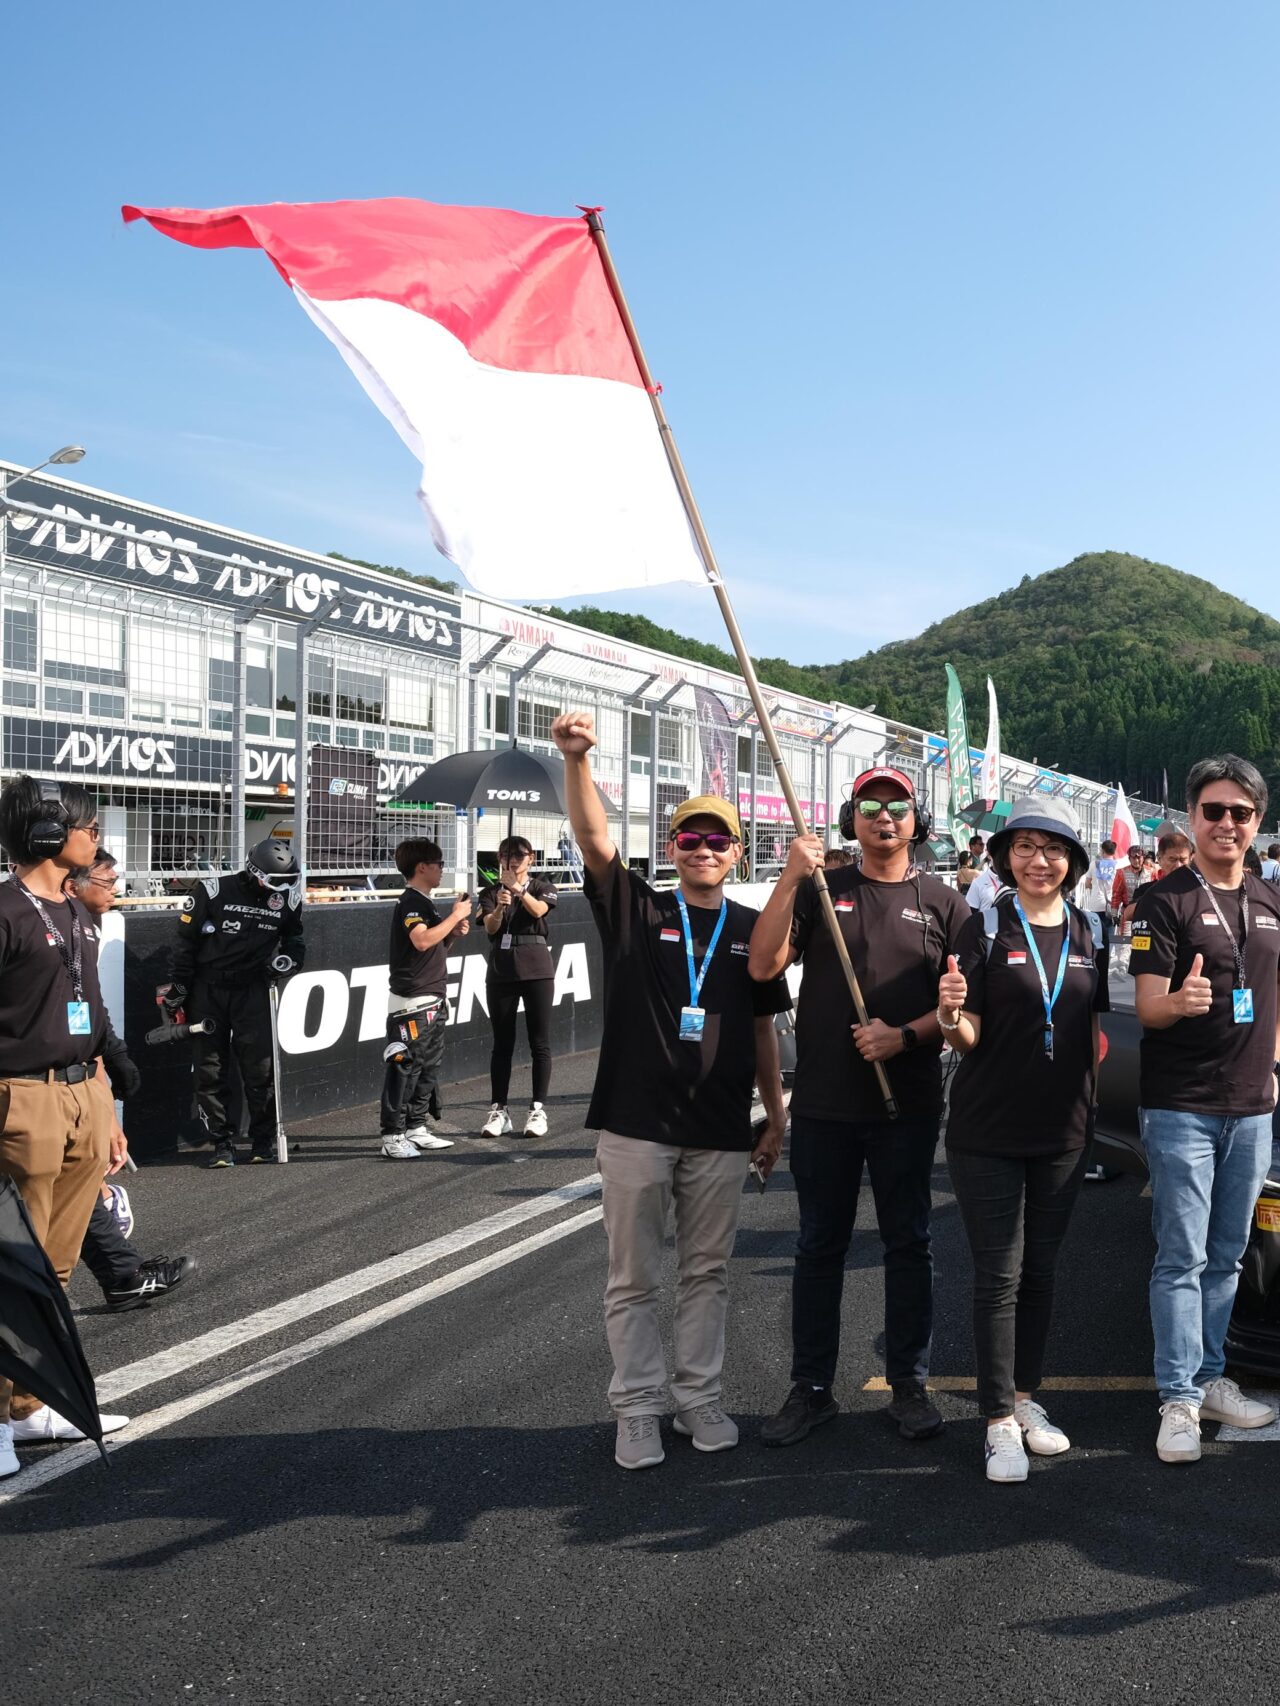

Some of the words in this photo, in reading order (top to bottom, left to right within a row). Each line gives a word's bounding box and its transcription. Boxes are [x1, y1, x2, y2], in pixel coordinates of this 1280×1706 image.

[29, 503, 200, 585] ADVICS
[352, 590, 453, 646] ADVICS
[510, 619, 555, 645] YAMAHA
[592, 645, 627, 664] YAMAHA
[52, 731, 177, 773] ADVICS
[486, 789, 541, 802] TOM'S
[277, 942, 593, 1055] OTENA
